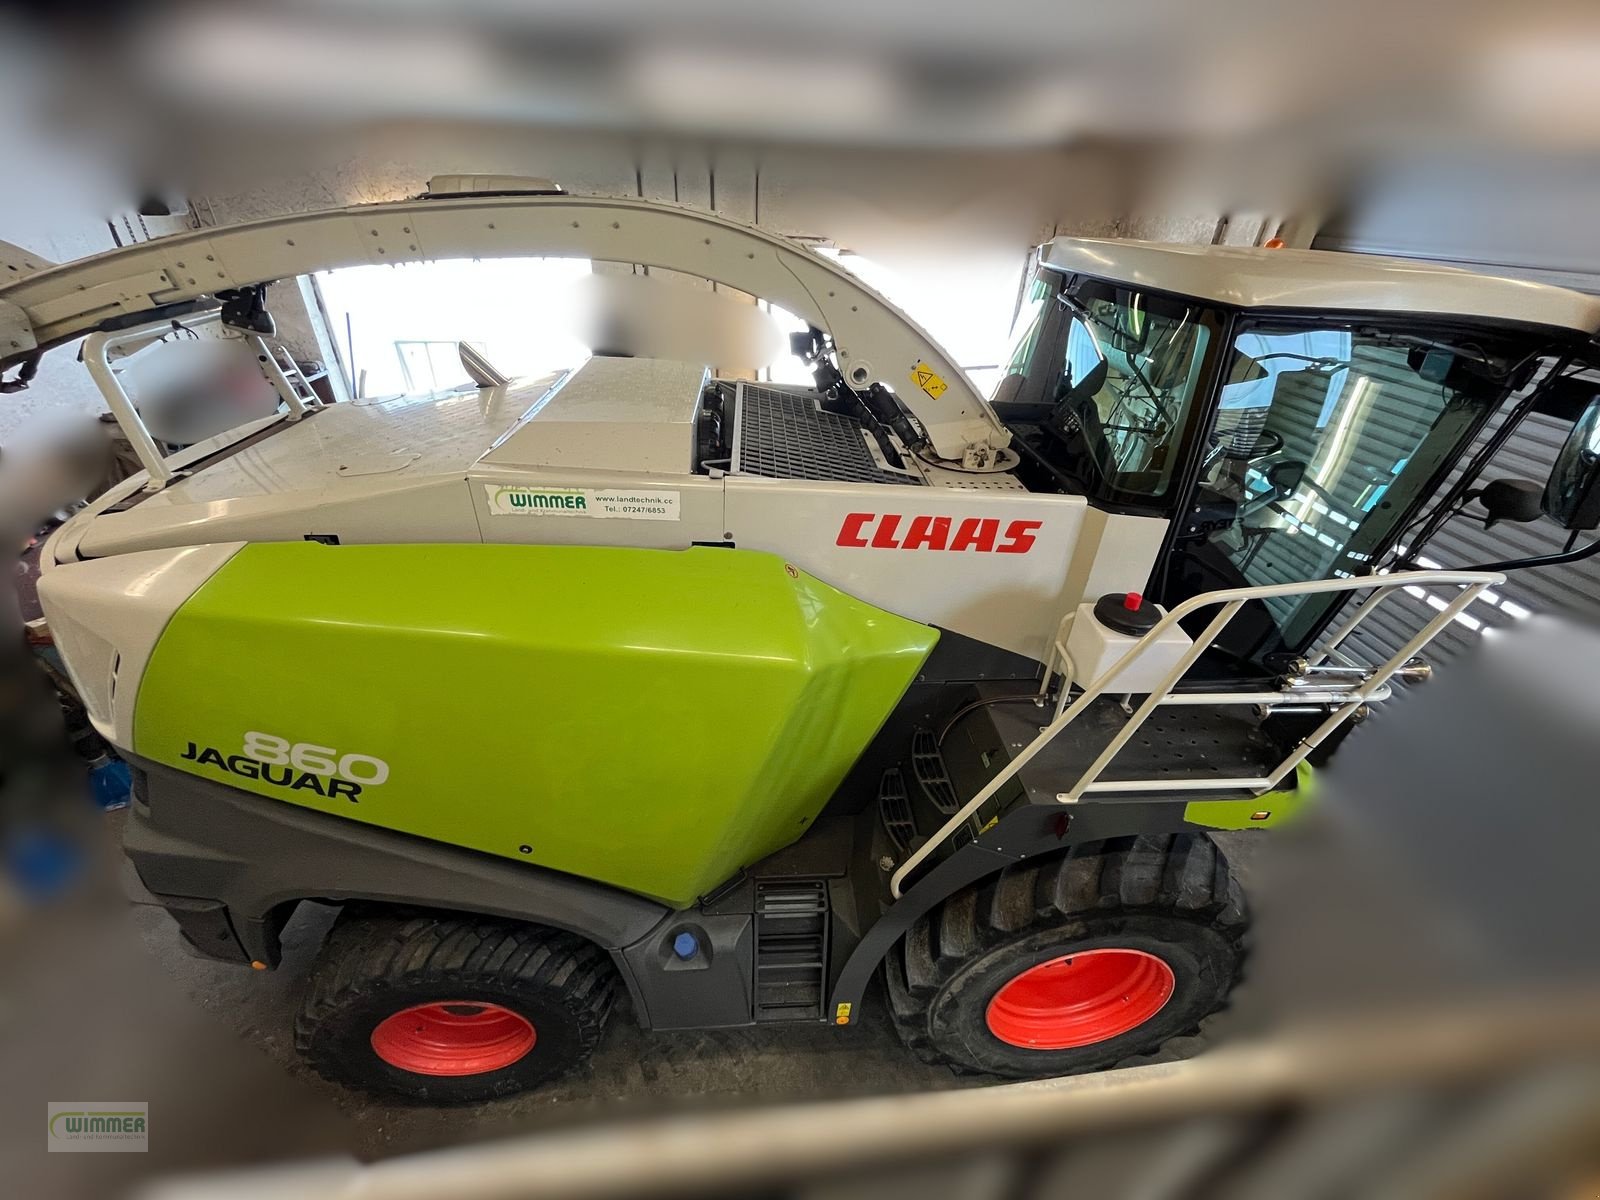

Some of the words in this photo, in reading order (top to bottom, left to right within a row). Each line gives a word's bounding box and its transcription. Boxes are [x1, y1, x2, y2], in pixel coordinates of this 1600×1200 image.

[510, 493, 587, 509] WIMMER
[595, 495, 673, 504] www.landtechnik.cc
[623, 506, 666, 514] 07247/6853
[836, 513, 1043, 554] CLAAS
[243, 731, 389, 785] 860
[181, 742, 362, 803] JAGUAR
